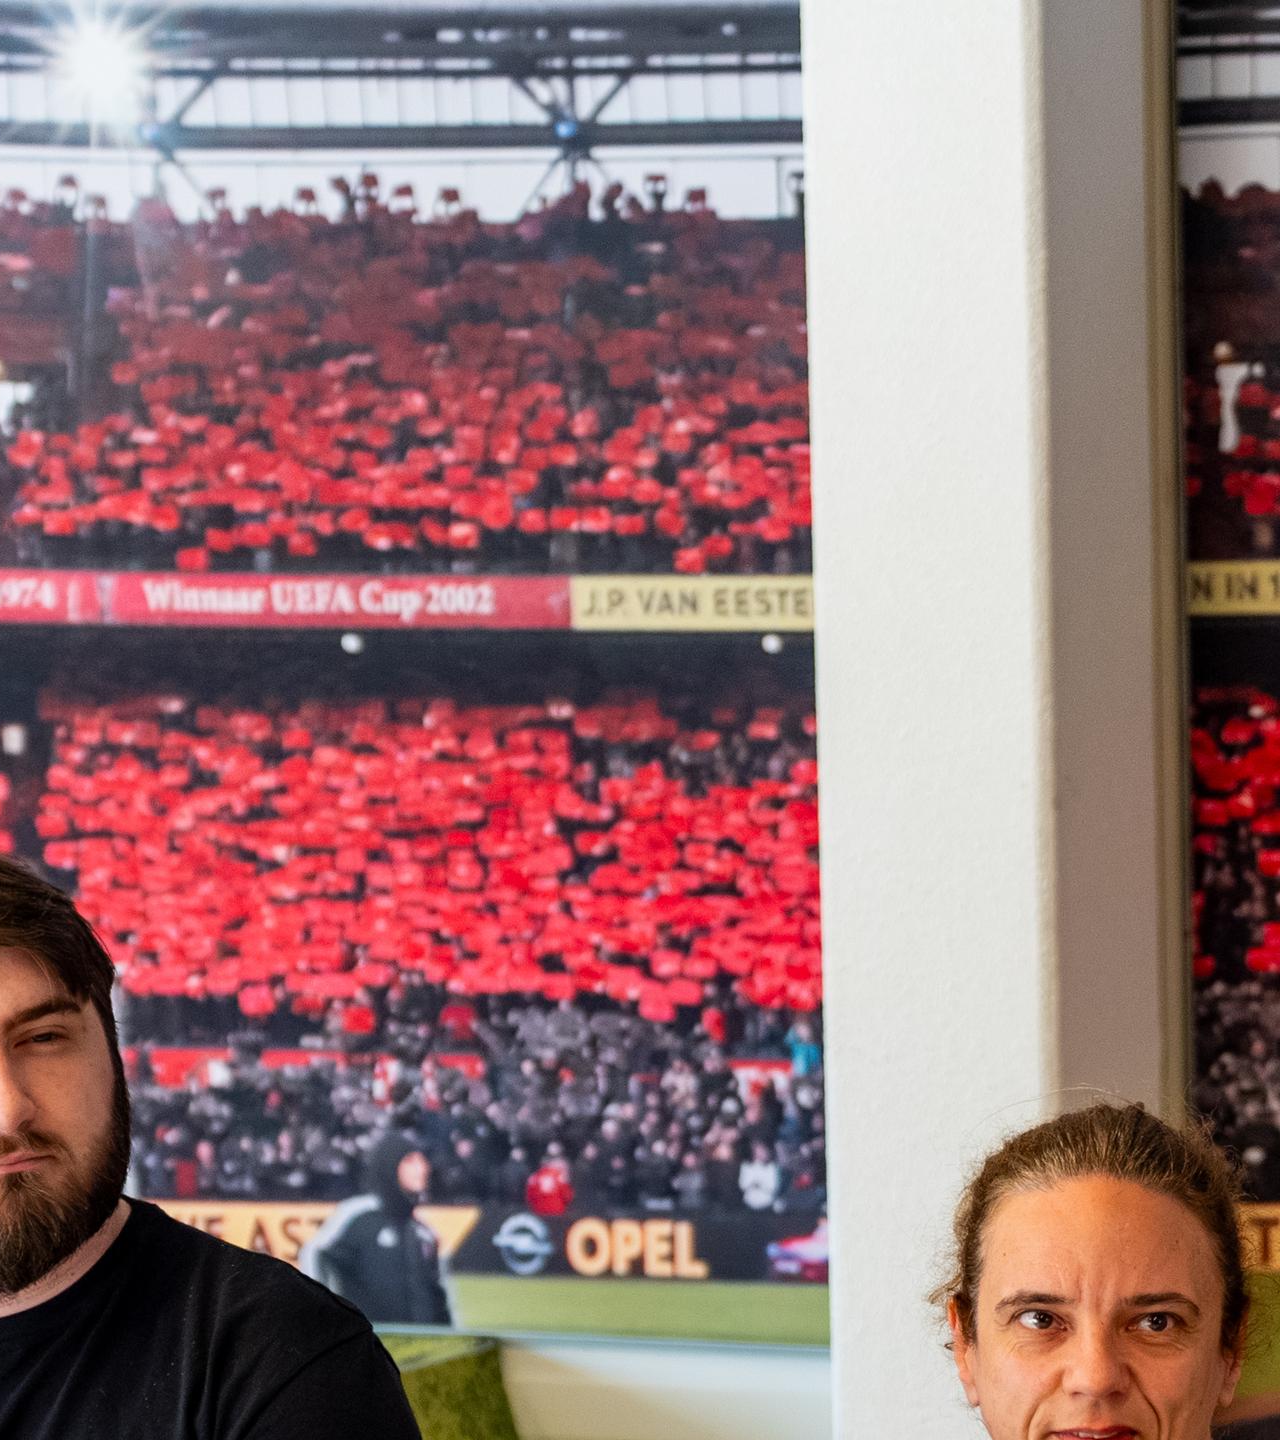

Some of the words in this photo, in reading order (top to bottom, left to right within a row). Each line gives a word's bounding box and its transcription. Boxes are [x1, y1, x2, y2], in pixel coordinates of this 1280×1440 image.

[142, 579, 267, 613] Winnaar
[270, 581, 357, 614] UEFA
[359, 580, 422, 624] Cup
[424, 583, 496, 616] 2002
[637, 588, 701, 616] VAN
[1224, 573, 1259, 600] IN
[565, 1216, 711, 1280] OPEL
